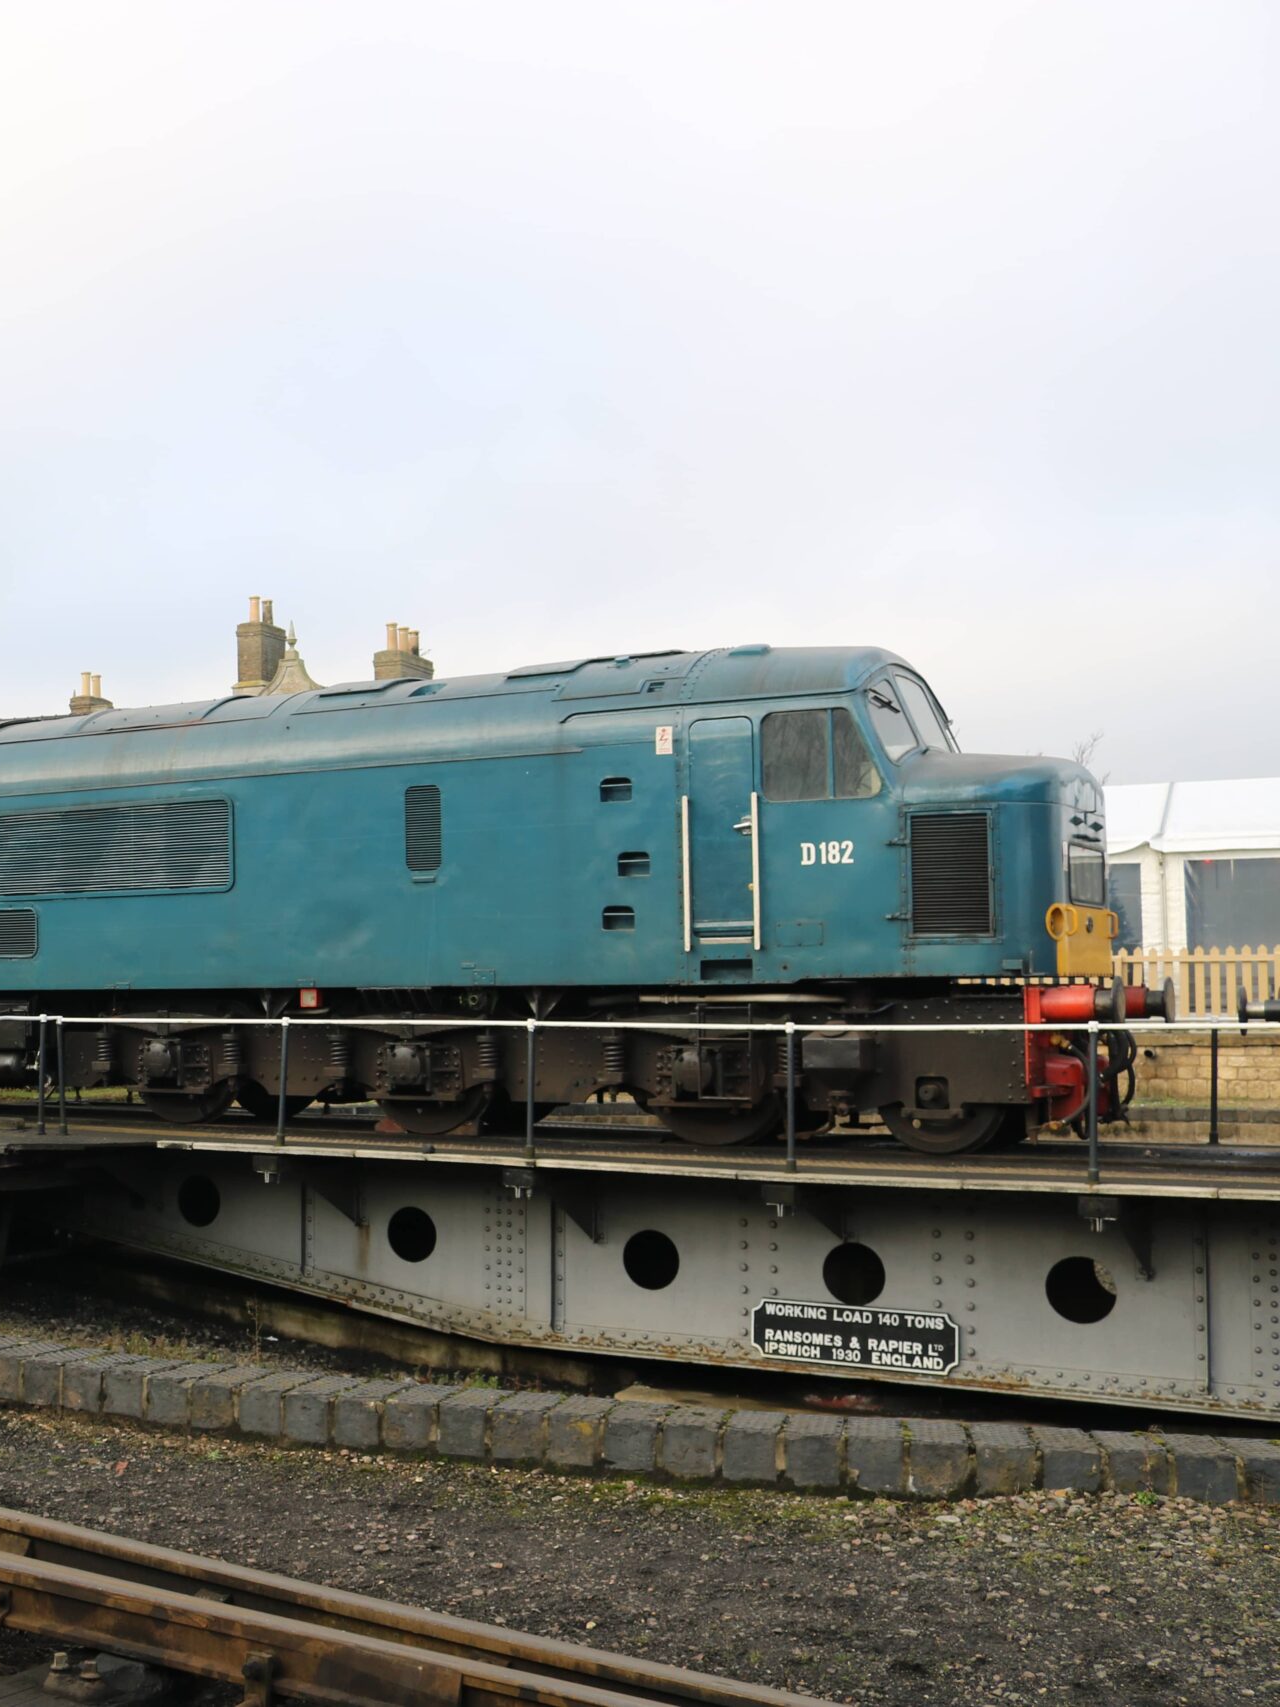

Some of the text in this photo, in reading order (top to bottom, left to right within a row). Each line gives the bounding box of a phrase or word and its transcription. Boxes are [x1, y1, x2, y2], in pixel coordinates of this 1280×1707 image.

[765, 1303, 945, 1330] WORKING LOAD 140 TONS
[765, 1328, 843, 1347] RANSOMES
[849, 1336, 861, 1349] &
[867, 1338, 923, 1355] RAPIER
[764, 1341, 944, 1370] IPSWICH 1930 ENGLAND
